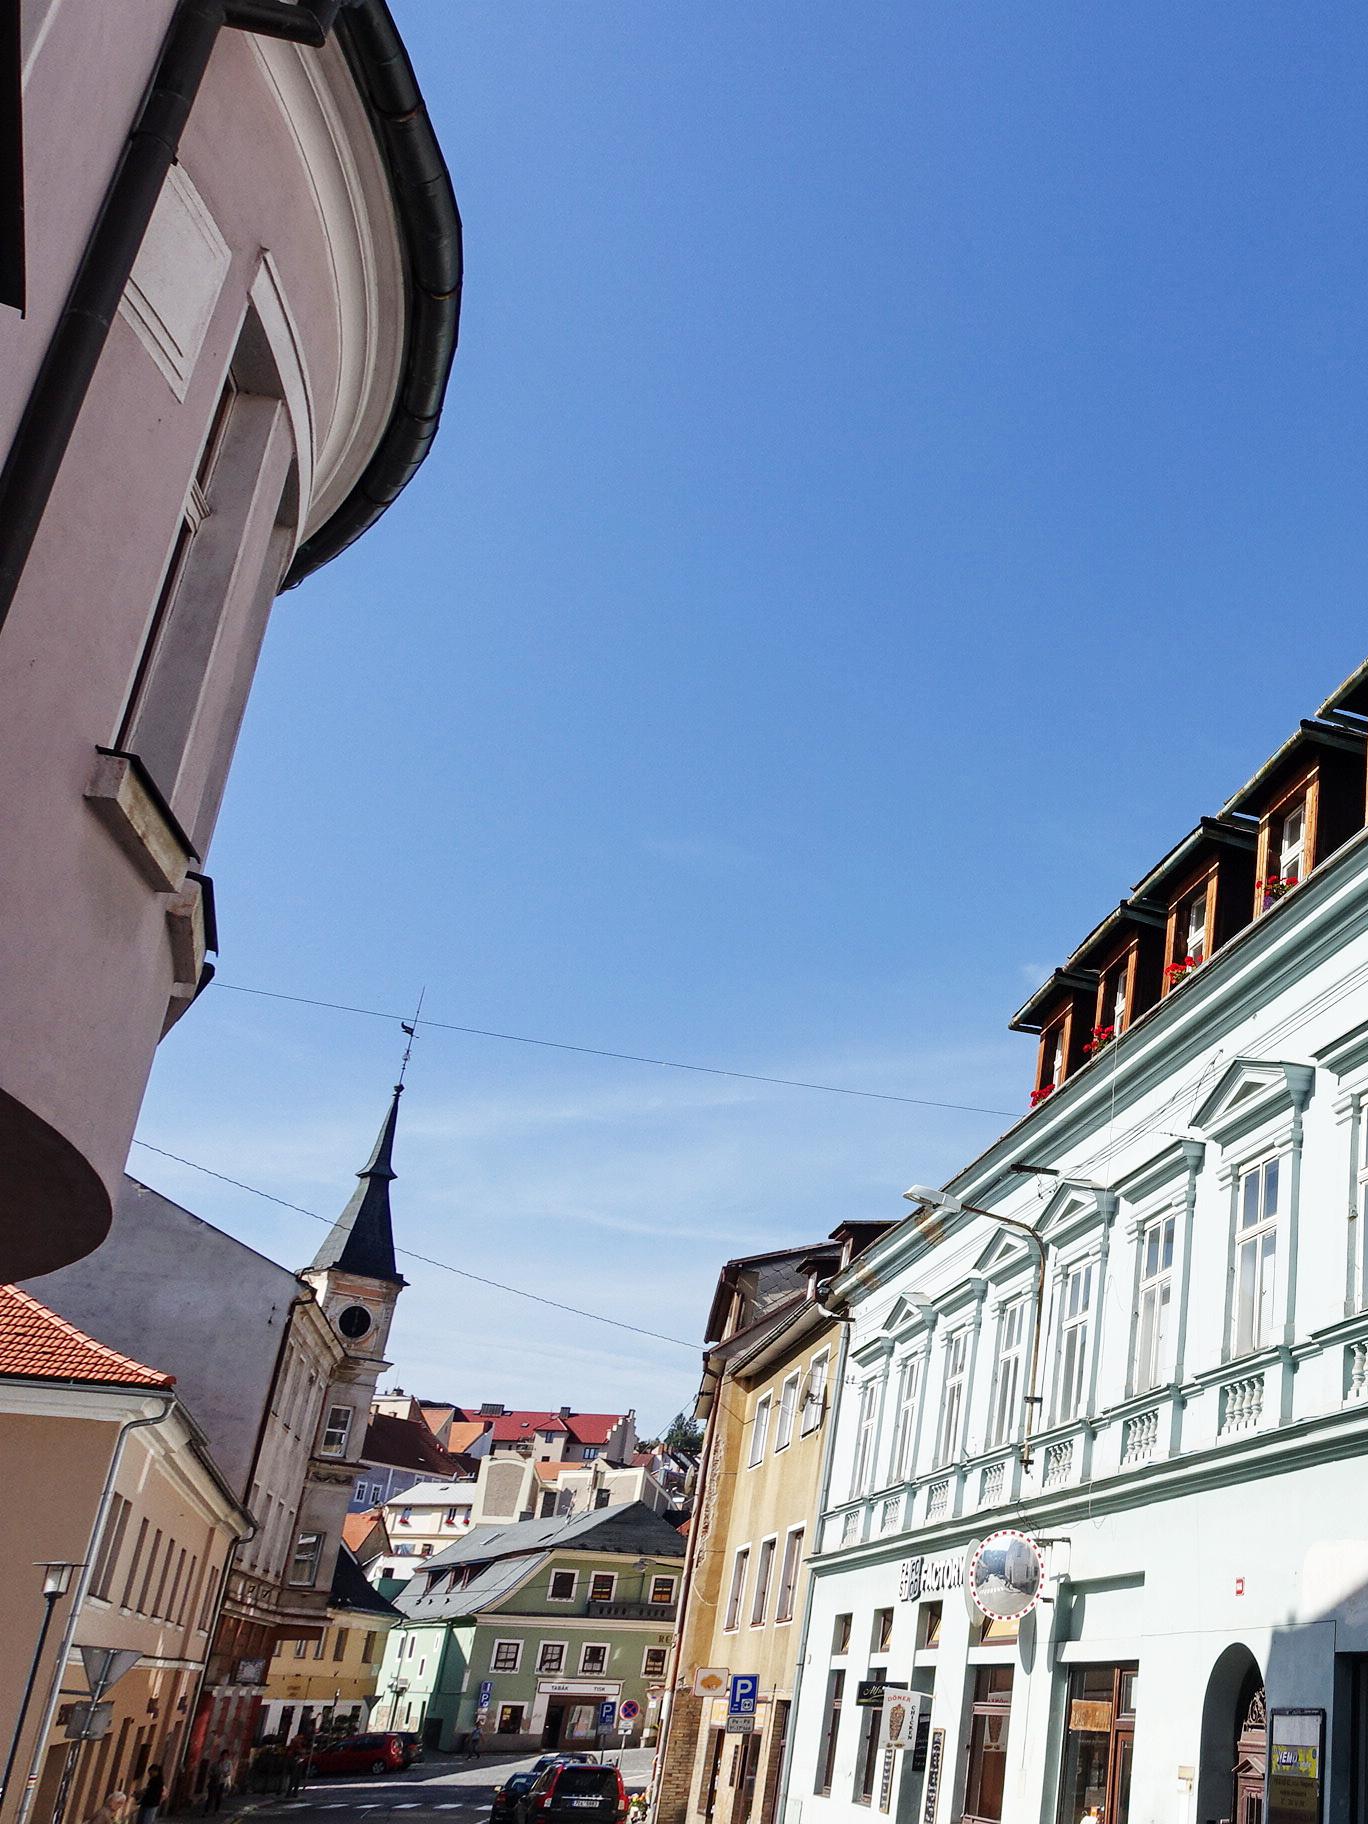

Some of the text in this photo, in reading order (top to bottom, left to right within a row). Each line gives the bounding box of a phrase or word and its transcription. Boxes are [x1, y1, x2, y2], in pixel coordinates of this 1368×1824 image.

[736, 1679, 752, 1702] P
[888, 1694, 911, 1702] DÖNER
[907, 1705, 916, 1740] CHICKEN
